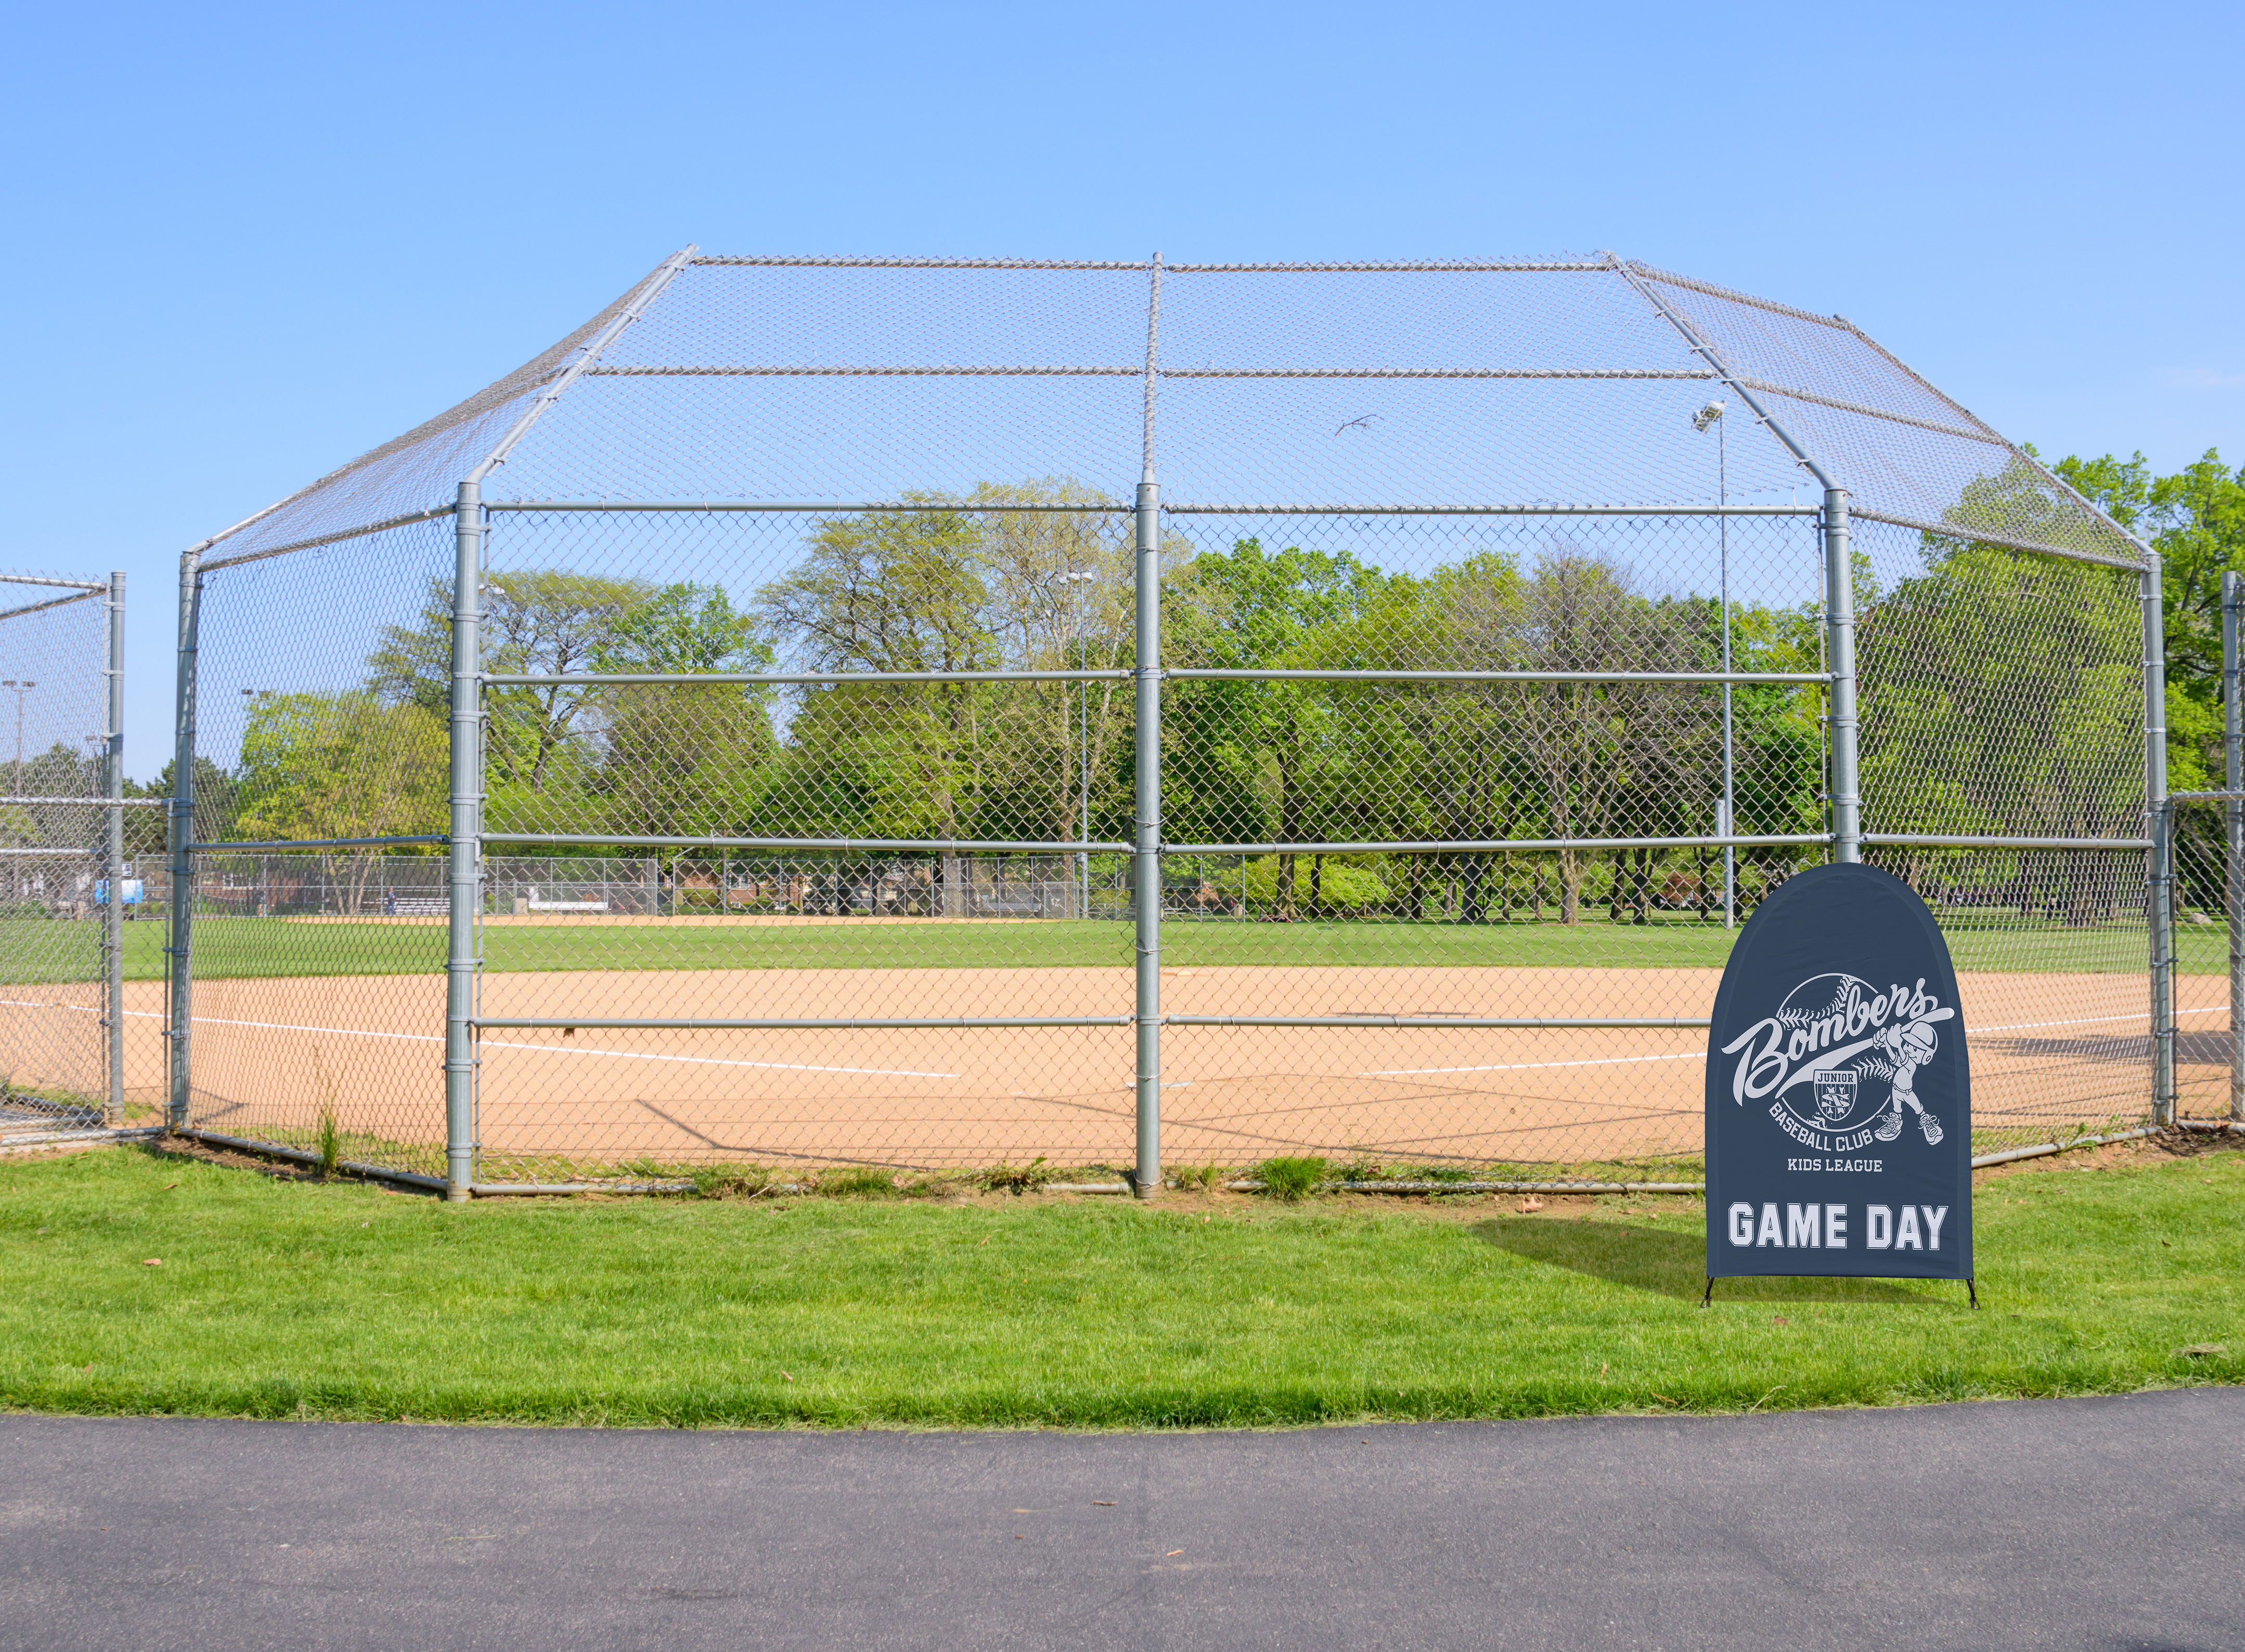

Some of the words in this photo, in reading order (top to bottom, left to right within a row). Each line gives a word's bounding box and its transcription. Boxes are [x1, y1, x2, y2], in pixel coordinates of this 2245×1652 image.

[1721, 978, 1938, 1106] Bombers
[1817, 1073, 1853, 1082] JUNIOR
[1769, 1102, 1831, 1152] BASEBALL
[1835, 1128, 1873, 1152] CLUB
[1787, 1158, 1821, 1171] KIDS
[1825, 1159, 1882, 1172] LEAGUE
[1728, 1202, 1847, 1248] GAME
[1866, 1204, 1949, 1250] DAY
